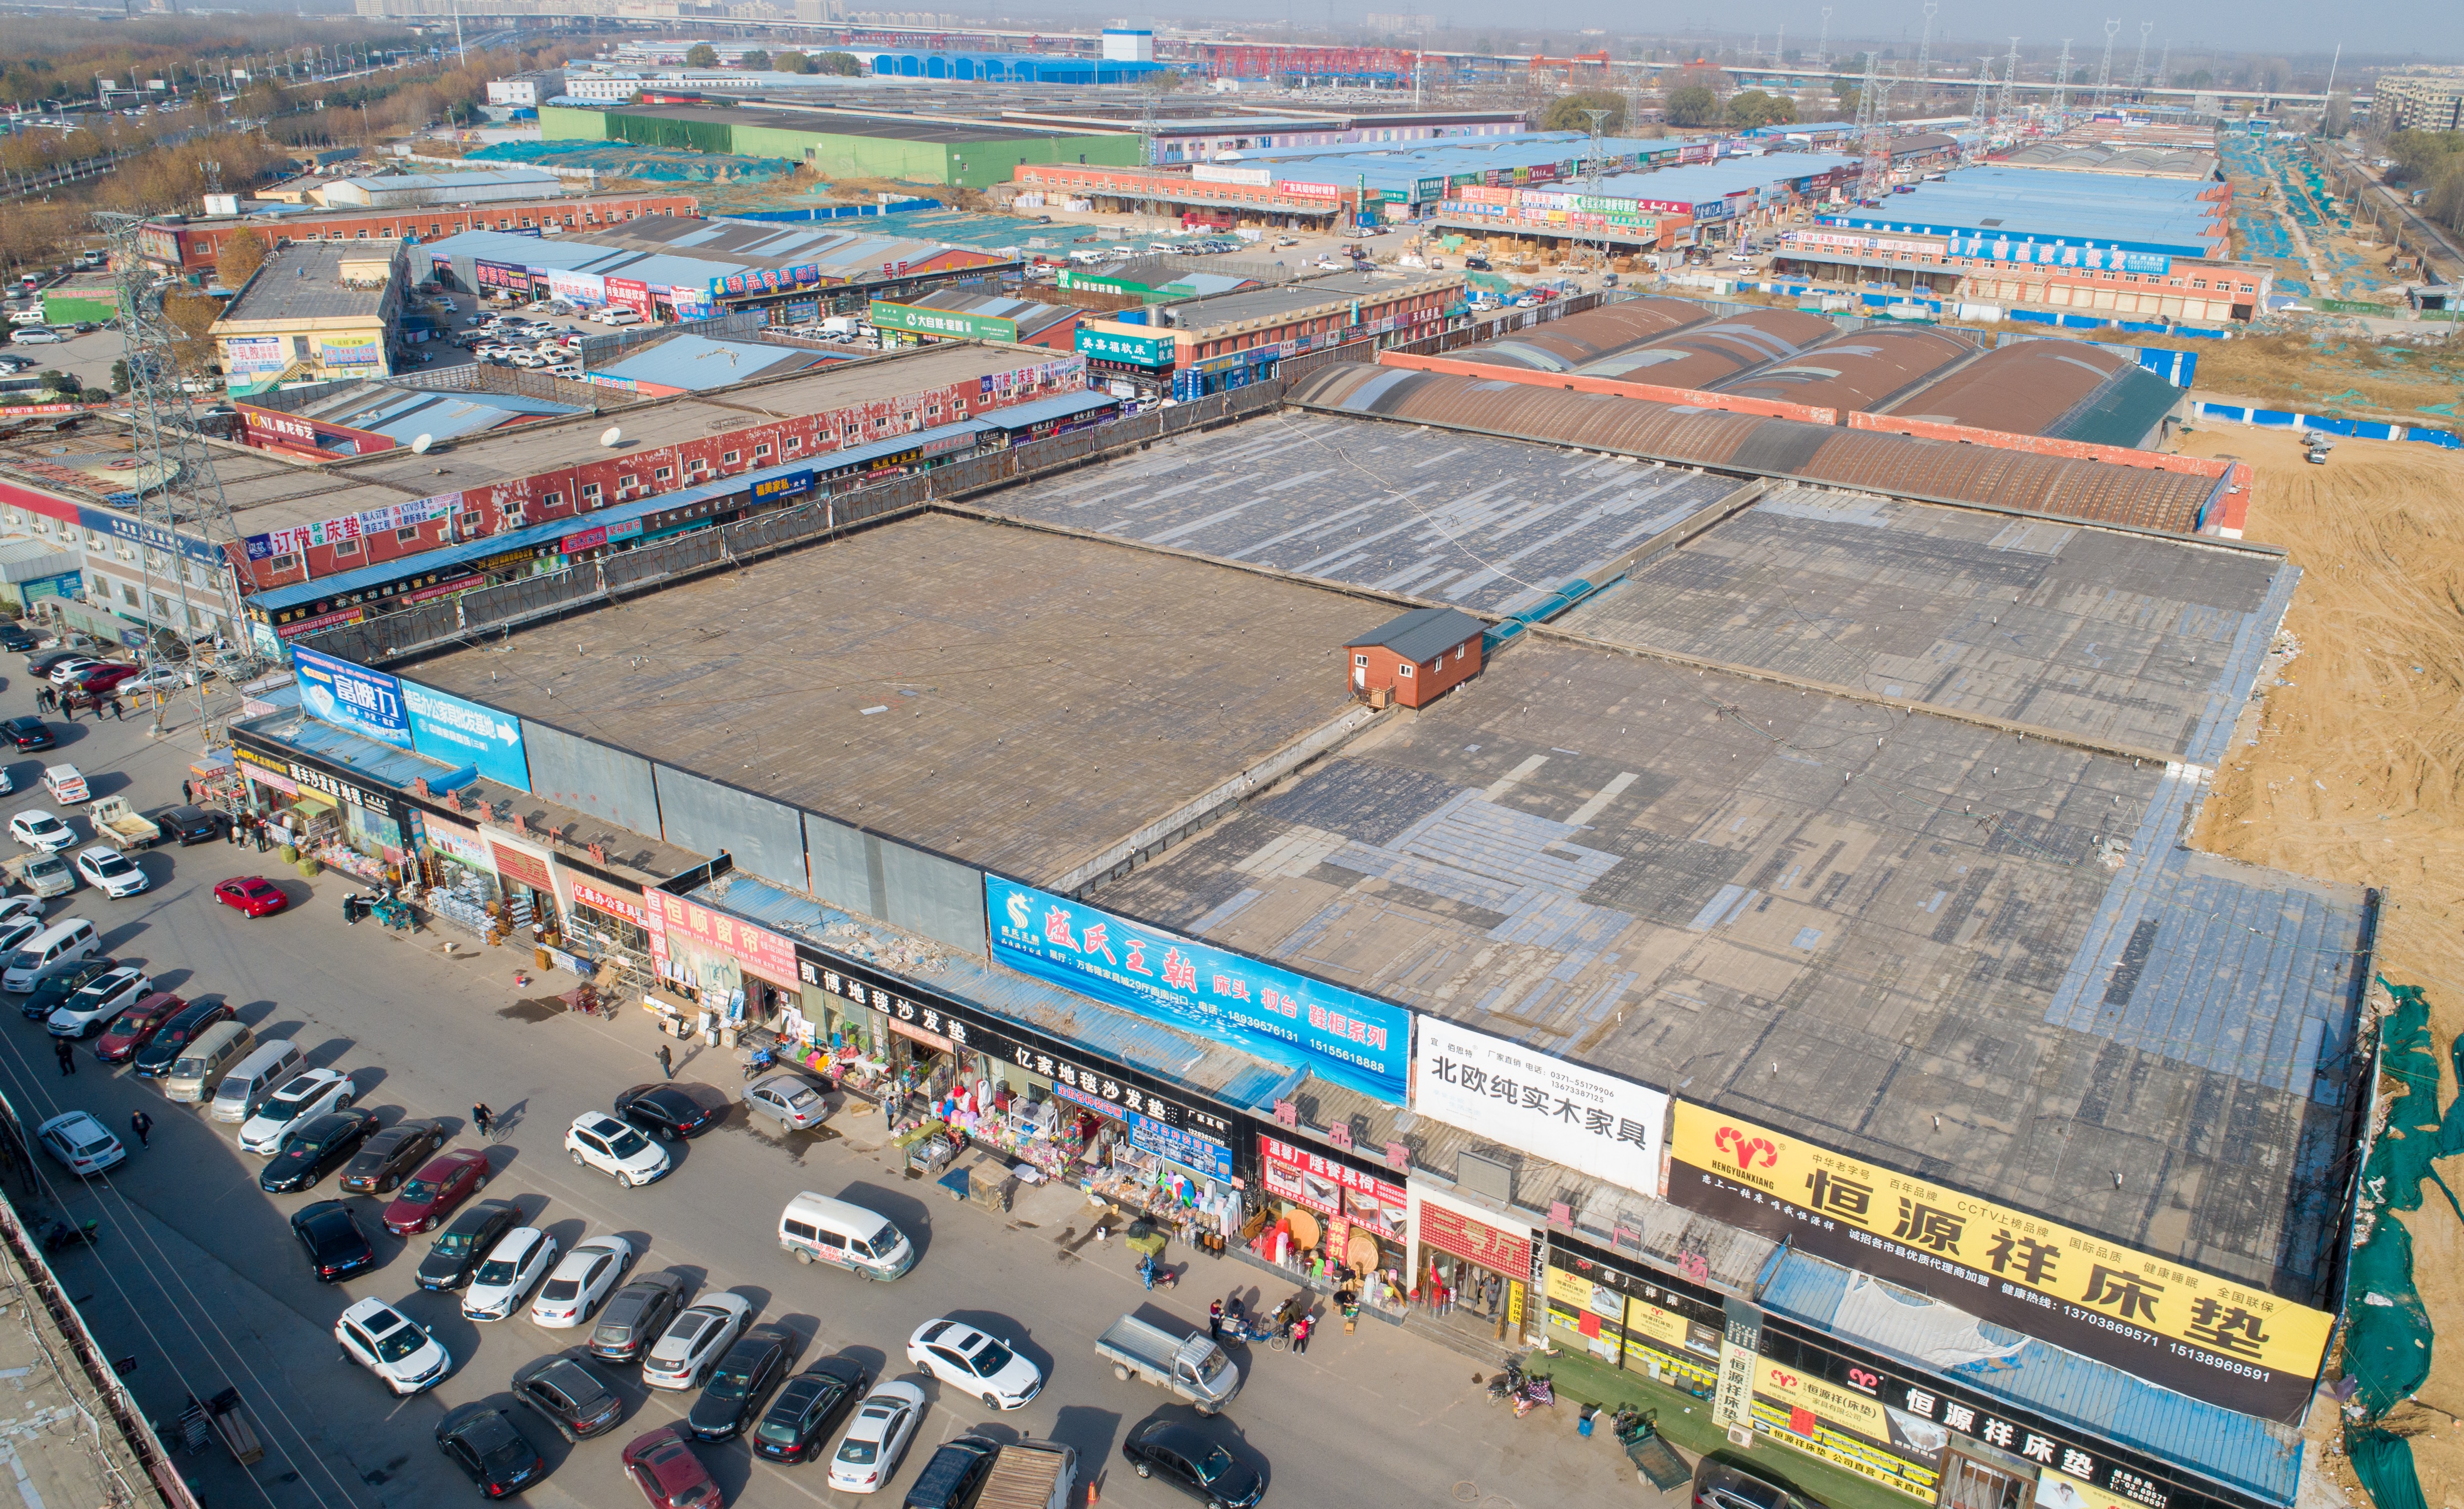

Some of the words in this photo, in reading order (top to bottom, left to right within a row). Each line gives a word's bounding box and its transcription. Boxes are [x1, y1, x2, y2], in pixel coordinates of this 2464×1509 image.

[1993, 241, 2125, 270] 精品家具批发
[728, 270, 792, 293] 精品家具
[239, 346, 260, 360] 乳胶
[276, 419, 314, 440] 腾龙布艺
[756, 478, 789, 496] 福美家私
[333, 674, 398, 718] 富魄力
[404, 688, 496, 739] 精品办公家具批发基地
[237, 748, 258, 762] AIPU
[290, 764, 363, 806] 瑞丰沙发垫地毯
[574, 884, 636, 919] 亿鑫办公家具
[664, 895, 759, 953] 恒顺窗帘
[760, 932, 794, 950] 厂家直销
[1045, 905, 1197, 994] 盛氏王朝
[800, 961, 966, 1044] 凯博地毯沙发垫
[1213, 975, 1250, 1003] 床头
[1260, 988, 1297, 1019] 妆台
[1309, 1004, 1386, 1051] 鞋柜系列
[1310, 1038, 1385, 1073] 15155618888
[1488, 1050, 1521, 1068] 厂家直销
[1550, 1071, 1614, 1098] 0371-55179906
[1015, 1046, 1167, 1121] 亿家地毯沙发垫
[1057, 1085, 1123, 1118] 定做各种装饰画
[1551, 1080, 1604, 1103] 13673387125
[1188, 1110, 1225, 1131] 厂家直销
[1432, 1056, 1646, 1151] 北欧纯实木家具
[1139, 1117, 1214, 1154] 批发各种装饰画
[1377, 1184, 1407, 1199] 1803920308
[1712, 1159, 1774, 1191] HENGYUANXIANG
[1328, 1222, 1346, 1259] 麻将机
[1812, 1154, 1870, 1180] 中华老字号
[1890, 1178, 1938, 1202] 百年品牌
[1957, 1201, 2049, 1238] CCTV上榜品牌
[2069, 1236, 2123, 1263] 国际品质
[2144, 1261, 2199, 1289] 健康睡眠
[2217, 1287, 2274, 1313] 全国联保
[1804, 1167, 2270, 1360] 恒源祥床垫
[1604, 1269, 1678, 1306] 恒祥床
[1770, 1200, 1835, 1233] 唯我恒源祥
[1848, 1228, 1990, 1287] 诚招各市县优质代理商加盟
[2064, 1304, 2158, 1347] 13703869571
[2169, 1342, 2270, 1383] 15138969591
[1722, 1357, 1746, 1422] 恒源祥床垫
[1807, 1383, 1877, 1419] 恒源祥(床垫)
[1812, 1397, 1861, 1422] 家具有限公司
[1906, 1387, 2093, 1480] 恒源祥床垫
[1774, 1429, 1827, 1456] 恒源祥床垫
[1832, 1453, 1876, 1476] 公司直营
[1881, 1472, 1927, 1498] 厂家直销
